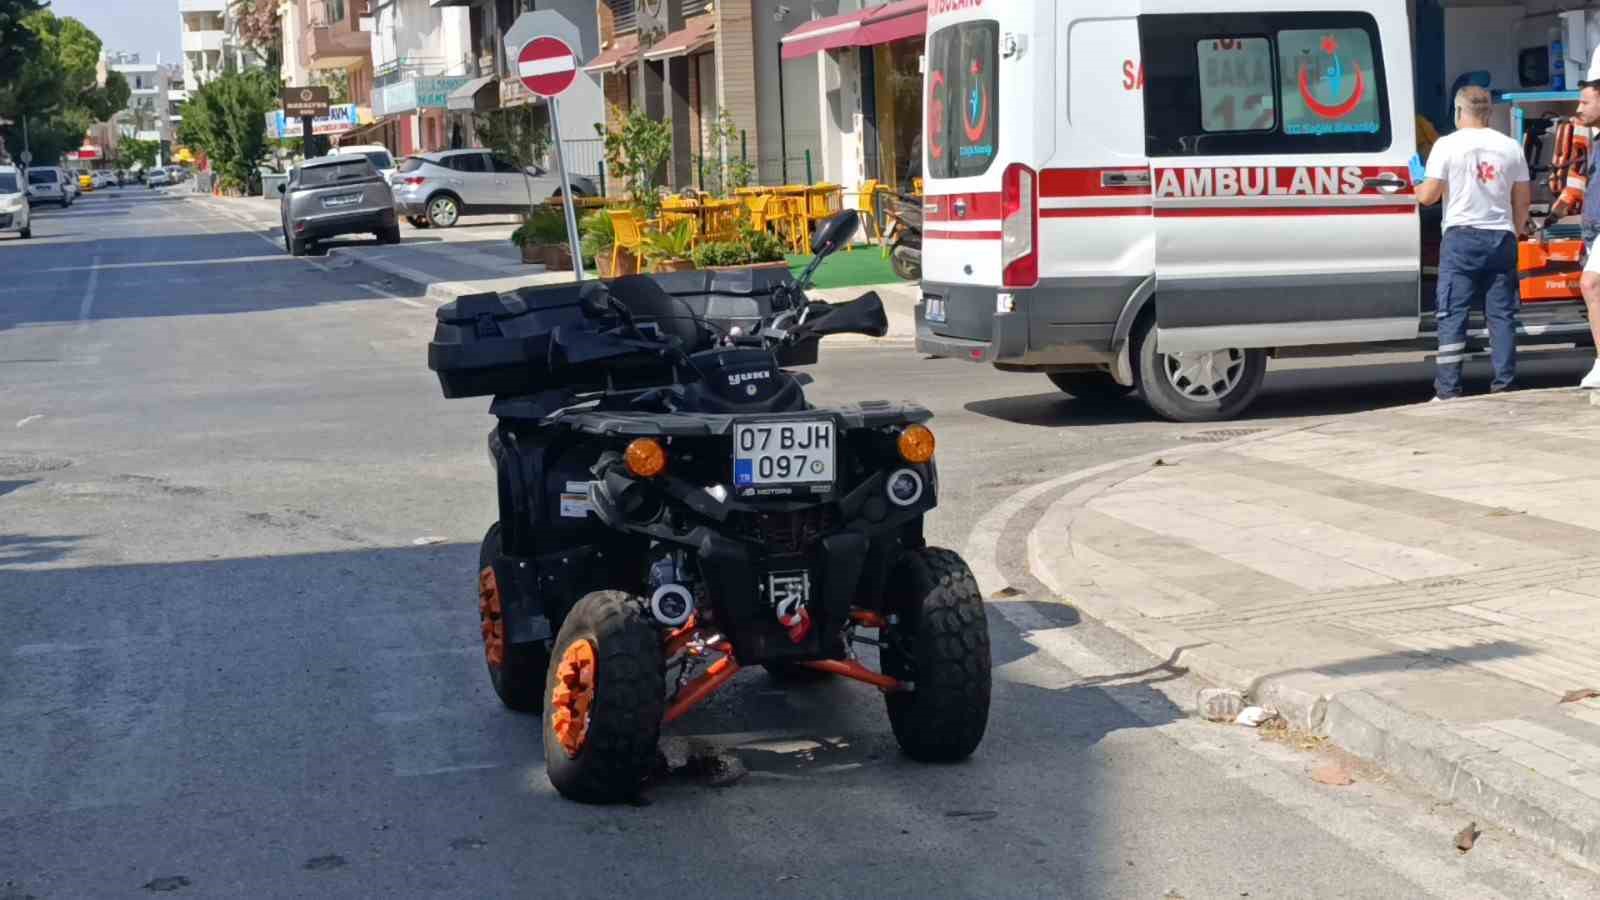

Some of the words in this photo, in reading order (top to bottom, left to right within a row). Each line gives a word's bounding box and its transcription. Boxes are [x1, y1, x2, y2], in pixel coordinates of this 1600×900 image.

[1155, 166, 1364, 198] AMBULANS
[740, 427, 772, 452] 07
[780, 425, 830, 450] BJH
[758, 454, 808, 479] 097
